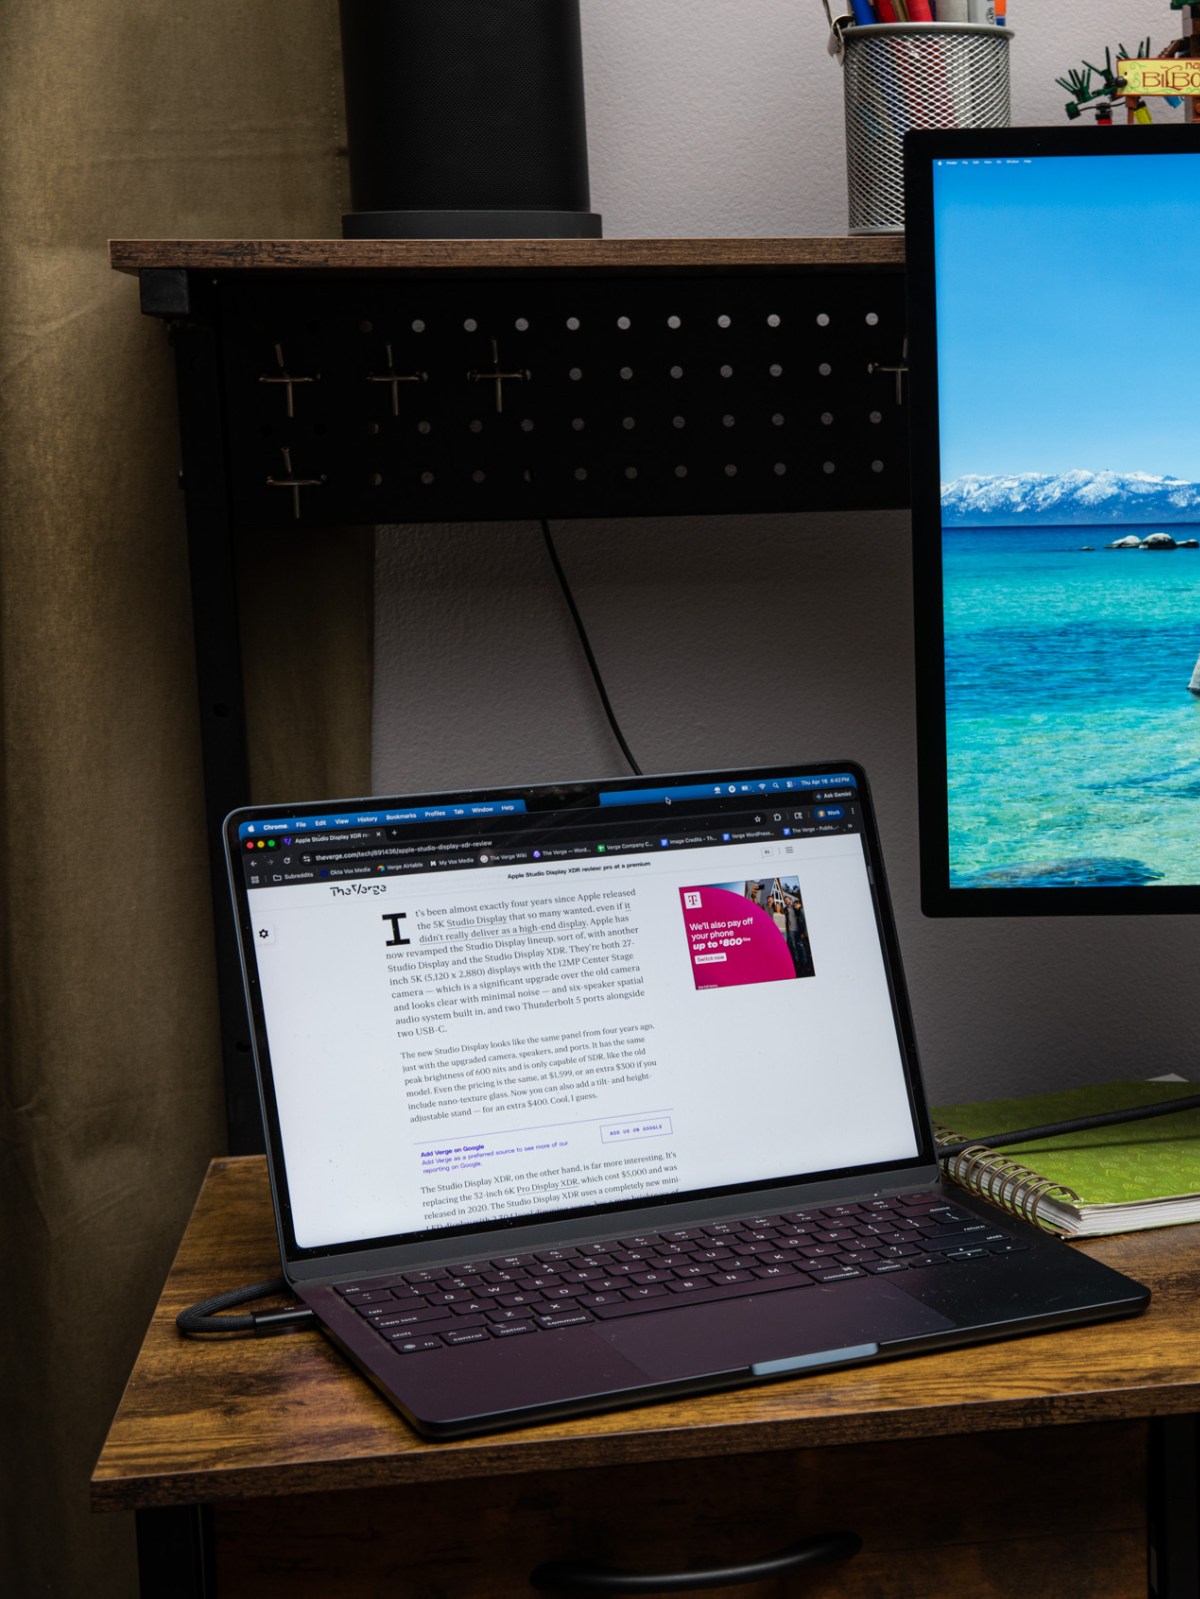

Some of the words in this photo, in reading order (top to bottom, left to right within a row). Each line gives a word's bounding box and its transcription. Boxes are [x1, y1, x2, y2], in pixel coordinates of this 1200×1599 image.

[262, 823, 288, 831] Chrome
[385, 812, 417, 820] Bookmarks
[507, 872, 525, 880] Apple
[524, 870, 545, 878] Studio
[626, 861, 651, 869] premium
[426, 908, 447, 916] been
[449, 904, 478, 914] almost
[479, 900, 509, 911] exactly
[510, 899, 529, 908] four
[530, 898, 553, 908] years
[554, 895, 576, 903] since
[577, 891, 601, 902] Apple
[602, 887, 636, 899] released
[416, 921, 431, 930] the
[432, 919, 445, 928] 5K
[446, 917, 475, 927] Studio
[476, 914, 507, 924] Display
[508, 912, 526, 921] that
[538, 910, 561, 918] many
[562, 905, 595, 915] wanted,
[595, 904, 615, 912] even
[616, 902, 623, 910] if
[418, 933, 444, 943] didn't
[445, 931, 468, 940] really
[470, 928, 499, 937] deliver
[518, 921, 557, 934] high-end
[557, 919, 588, 929] display.
[589, 915, 613, 926] Apple
[614, 915, 629, 923] has
[689, 921, 709, 931] We'll
[710, 921, 726, 929] also
[727, 920, 741, 928] pay
[742, 916, 753, 925] off
[385, 952, 404, 960] now
[405, 945, 448, 958] revamped
[449, 944, 463, 953] the
[465, 941, 494, 951] Studio
[494, 938, 525, 948] Display
[527, 936, 556, 944] lineup,
[556, 933, 574, 941] sort
[574, 931, 586, 939] of,
[587, 929, 606, 938] with
[607, 926, 639, 936] another
[690, 932, 709, 942] your
[709, 930, 734, 940] phone
[387, 962, 417, 973] Studio
[417, 959, 450, 970] Display
[451, 956, 468, 966] and
[468, 955, 483, 964] the
[484, 952, 513, 962] Studio
[513, 949, 544, 959] Display
[546, 946, 568, 955] XDR.
[568, 943, 600, 953] They're
[600, 940, 620, 950] both
[622, 938, 635, 948] 27-
[389, 976, 409, 986] inch
[410, 974, 423, 983] 5K
[423, 971, 450, 982] (5,120
[458, 968, 486, 978] 2,880)
[486, 965, 521, 975] displays
[522, 961, 541, 971] with
[542, 960, 556, 969] the
[557, 957, 581, 967] 12MP
[581, 956, 609, 965] Center
[611, 953, 634, 961] Stage
[391, 989, 424, 999] camera
[435, 983, 462, 994] which
[463, 983, 471, 991] is
[479, 977, 524, 990] significant
[524, 972, 559, 985] upgrade
[560, 972, 579, 980] over
[580, 969, 594, 978] the
[595, 966, 609, 976] old
[610, 965, 640, 974] camera
[393, 1002, 410, 1012] and
[411, 1000, 435, 1010] looks
[436, 998, 458, 1007] clear
[459, 994, 479, 1004] with
[480, 990, 516, 1002] minimal
[517, 989, 540, 998] noise
[551, 984, 567, 994] and
[568, 980, 615, 992] six-speaker
[616, 975, 644, 988] spatial
[395, 1015, 420, 1025] audio
[421, 1012, 452, 1023] system
[452, 1008, 473, 1018] built
[474, 1008, 486, 1016] in,
[486, 1004, 503, 1014] and
[504, 1004, 521, 1012] two
[521, 997, 574, 1010] Thunderbolt
[575, 996, 581, 1004] 5
[582, 995, 605, 1005] ports
[606, 988, 645, 1000] alongside
[396, 1030, 414, 1038] two
[415, 1024, 448, 1036] USB-C.
[420, 1150, 434, 1158] Add
[462, 1144, 485, 1152] Google
